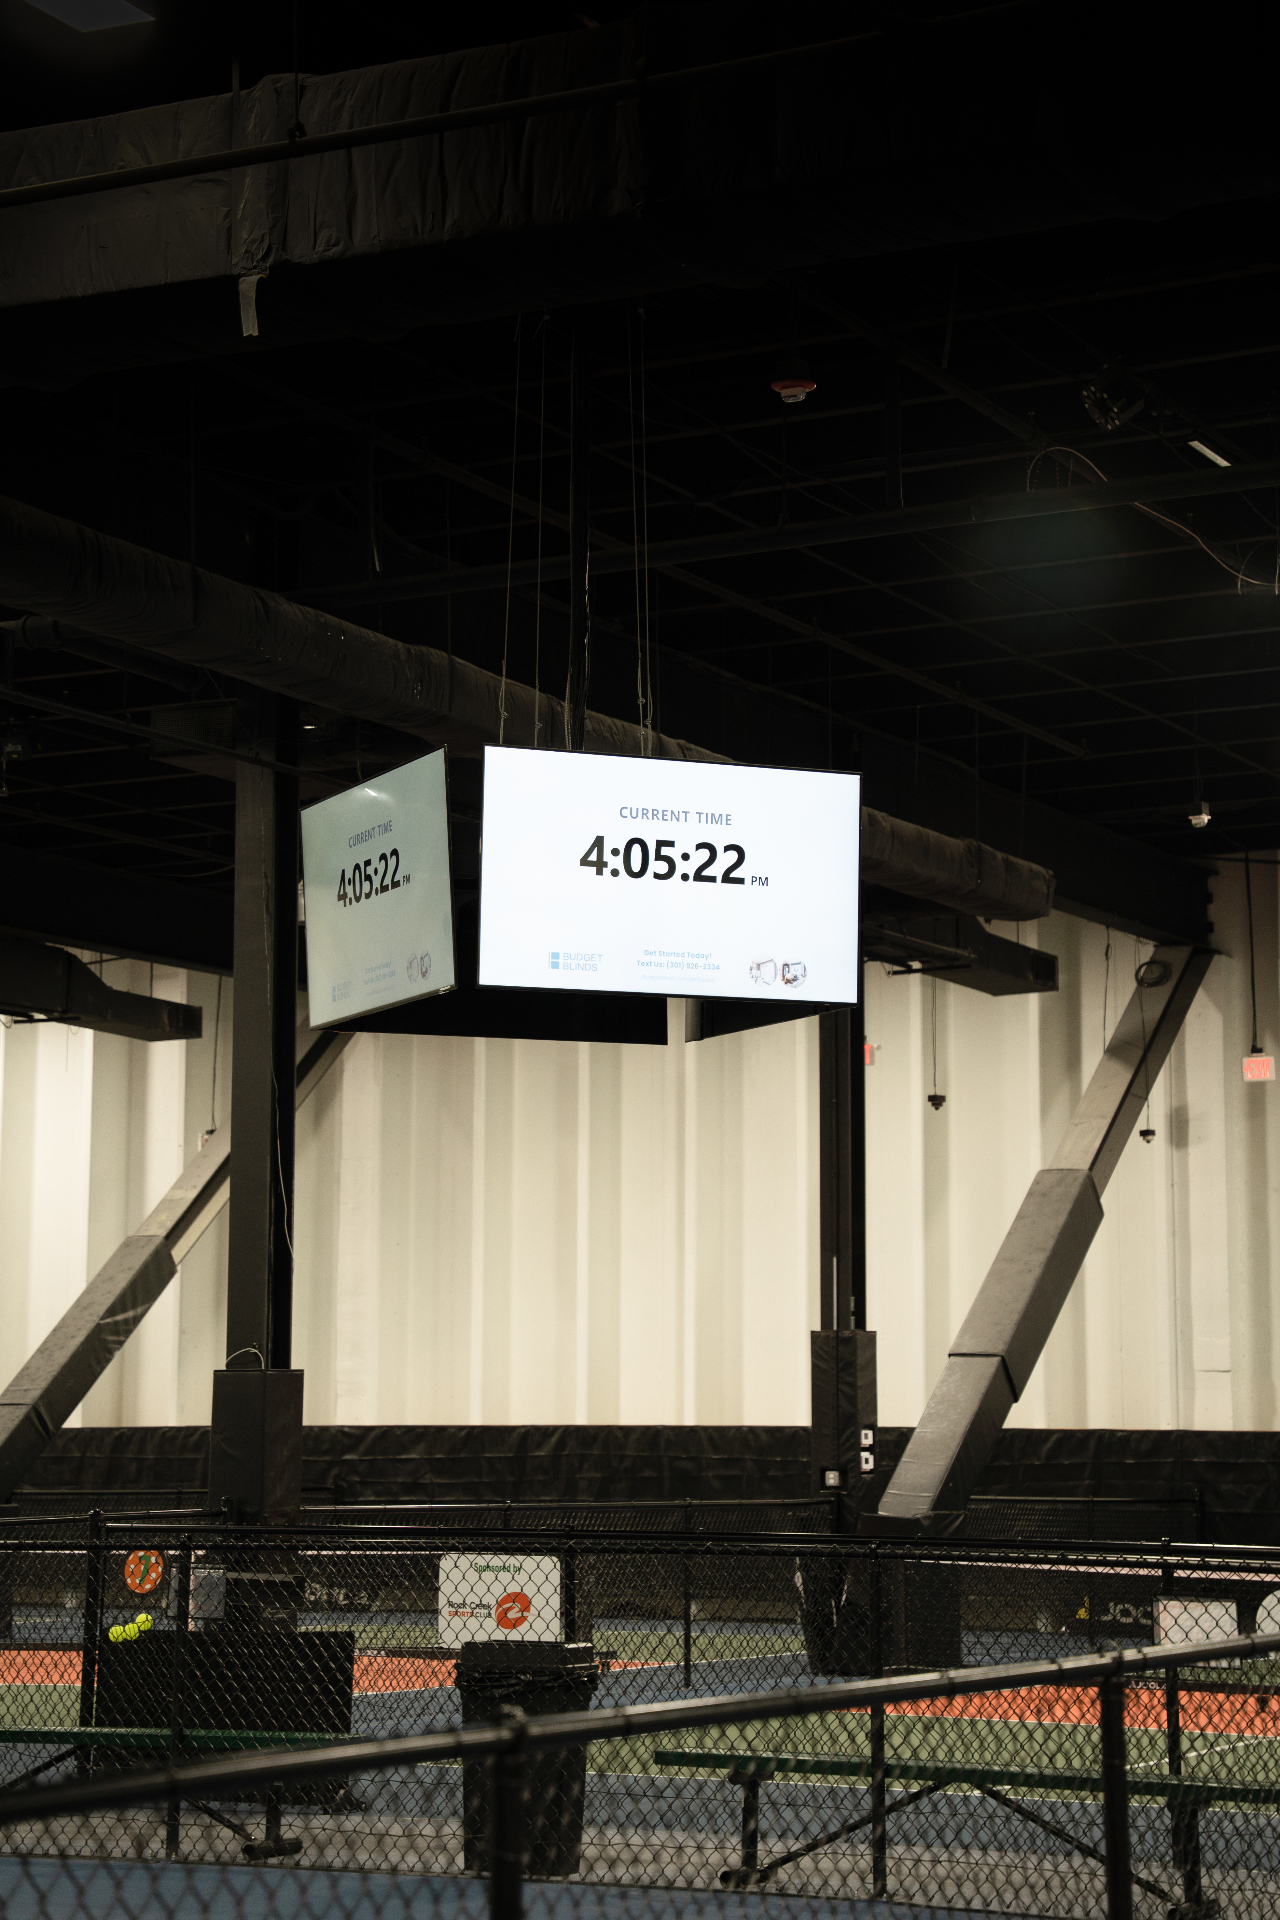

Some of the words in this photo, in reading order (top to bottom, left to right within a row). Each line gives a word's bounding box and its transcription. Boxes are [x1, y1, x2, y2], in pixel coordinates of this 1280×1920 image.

[619, 806, 690, 823] CURRENT
[696, 812, 732, 826] TIME
[348, 826, 376, 848] CURRENT
[377, 820, 392, 837] TIME
[579, 835, 746, 885] 4:05:22
[751, 875, 769, 887] PM
[337, 847, 401, 907] 4:05:22
[403, 873, 411, 886] PM
[563, 952, 603, 962] BUDGET
[643, 949, 656, 957] Get
[658, 950, 685, 958] Started
[687, 951, 712, 961] Today!
[562, 962, 598, 972] BLINDS
[666, 961, 684, 970] (301)
[686, 962, 720, 971] 926-2334
[1246, 1059, 1271, 1079] EXIT
[473, 1562, 511, 1574] Sponsored
[513, 1563, 522, 1576] by
[447, 1601, 468, 1610] Rock
[469, 1602, 493, 1611] Creek
[448, 1610, 473, 1618] SPORTS
[475, 1611, 493, 1619] CLUB
